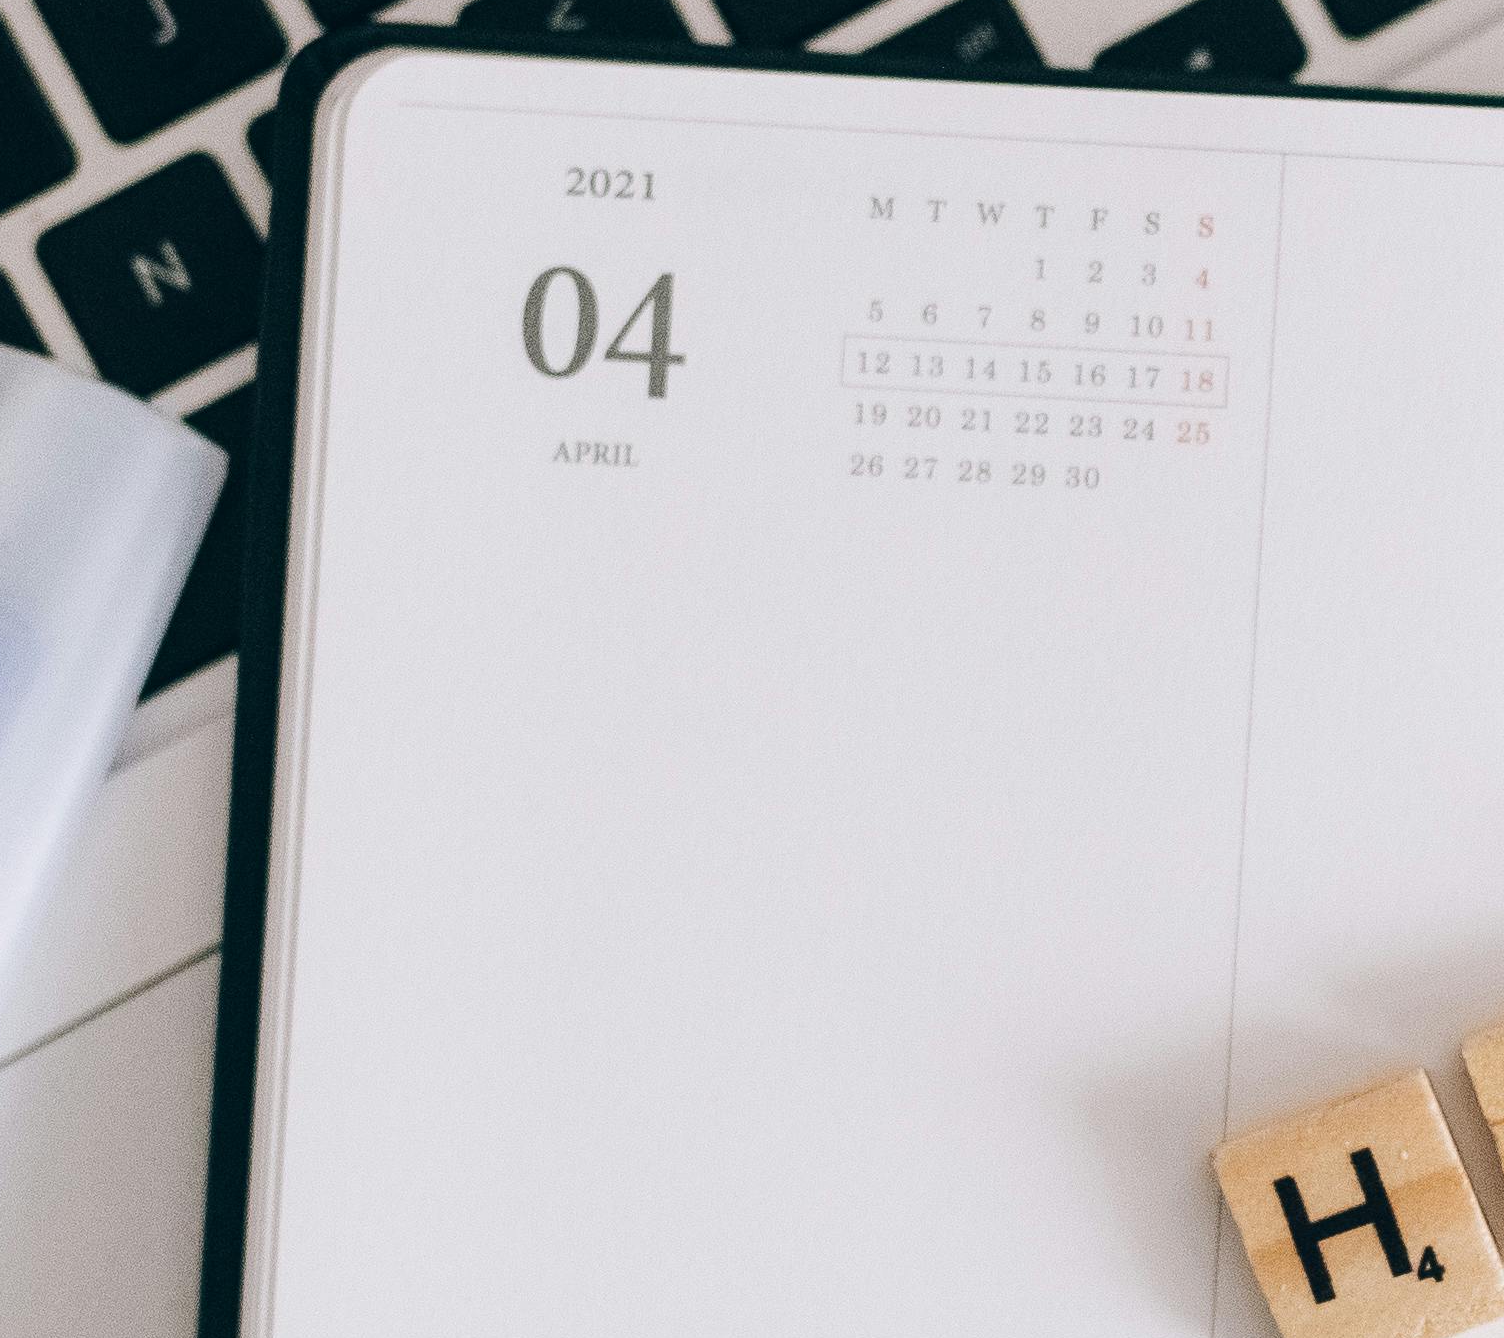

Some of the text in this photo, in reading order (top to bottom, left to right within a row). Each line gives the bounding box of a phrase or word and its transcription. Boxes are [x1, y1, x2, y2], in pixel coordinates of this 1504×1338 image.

[566, 166, 654, 201] 2021
[871, 196, 1214, 238] M T W T F S S
[132, 243, 191, 303] N
[1036, 257, 1209, 290] 1 2 3 4
[521, 265, 685, 399] 04
[868, 299, 1213, 342] 5 6 7 8 9 10 11
[859, 351, 1214, 392] 12 13 14 15 16 17 18
[856, 402, 1211, 444] 19 20 21 22 23 24 25
[552, 441, 636, 467] APRIL
[850, 455, 1101, 489] 26 27 28 29 30
